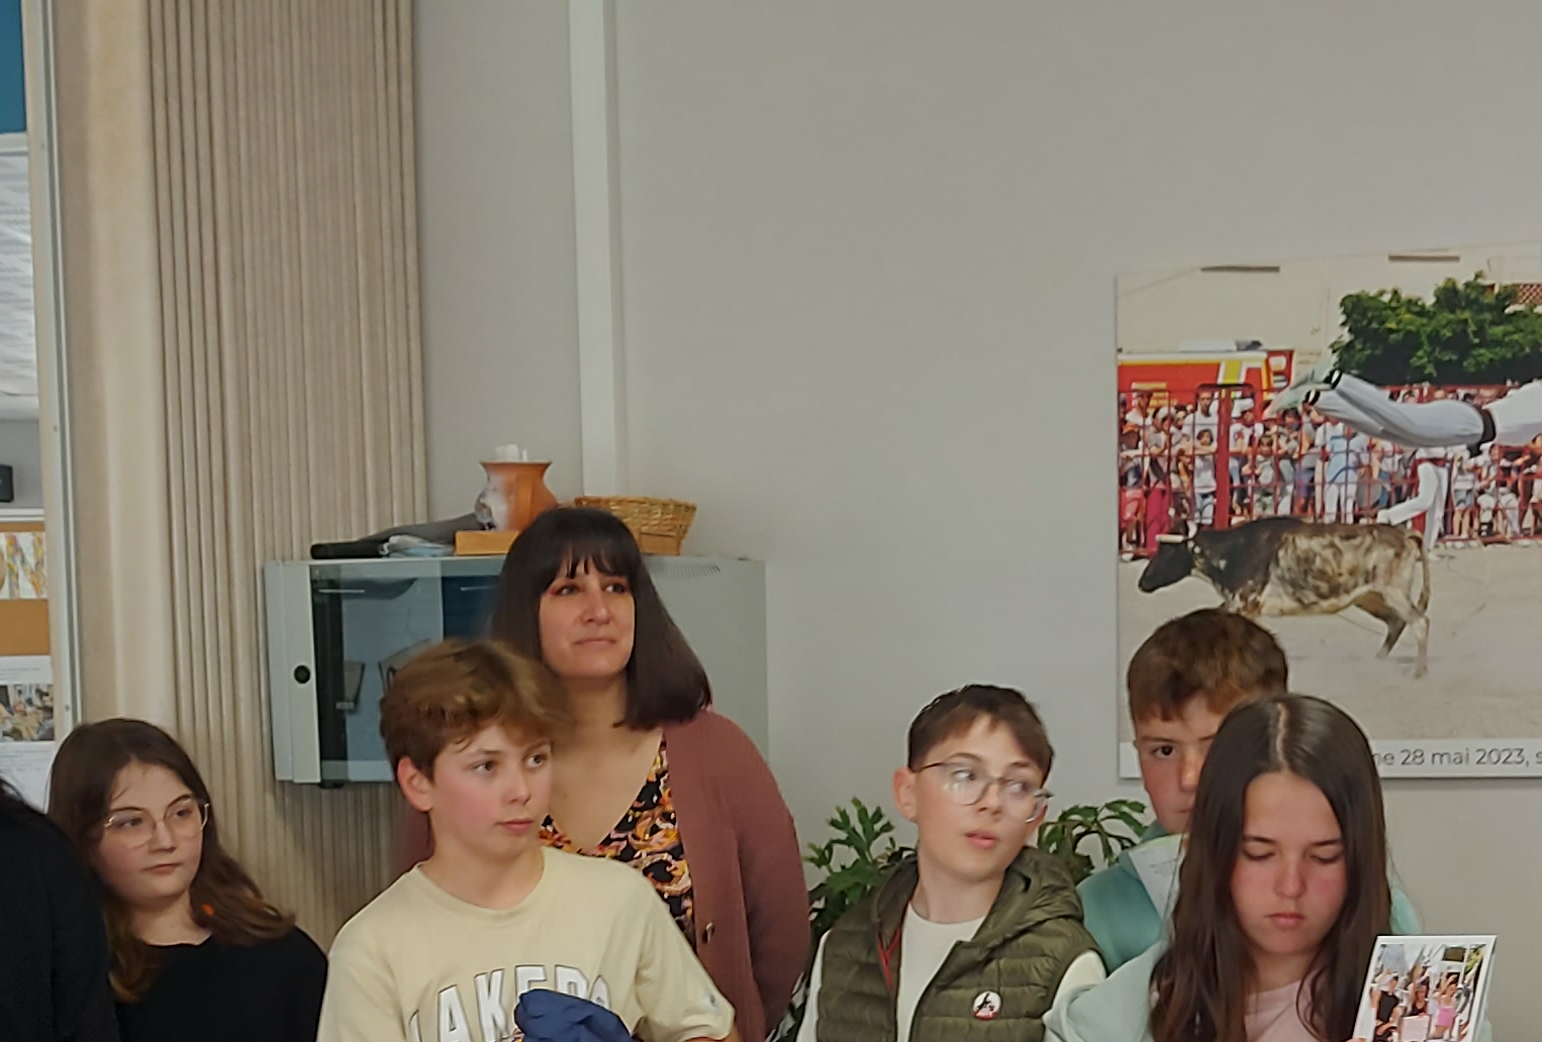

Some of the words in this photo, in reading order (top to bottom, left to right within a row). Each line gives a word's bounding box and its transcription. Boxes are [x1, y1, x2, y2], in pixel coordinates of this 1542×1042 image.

[1399, 749, 1425, 765] 28
[1431, 748, 1470, 765] mai
[1475, 747, 1530, 767] 2023,
